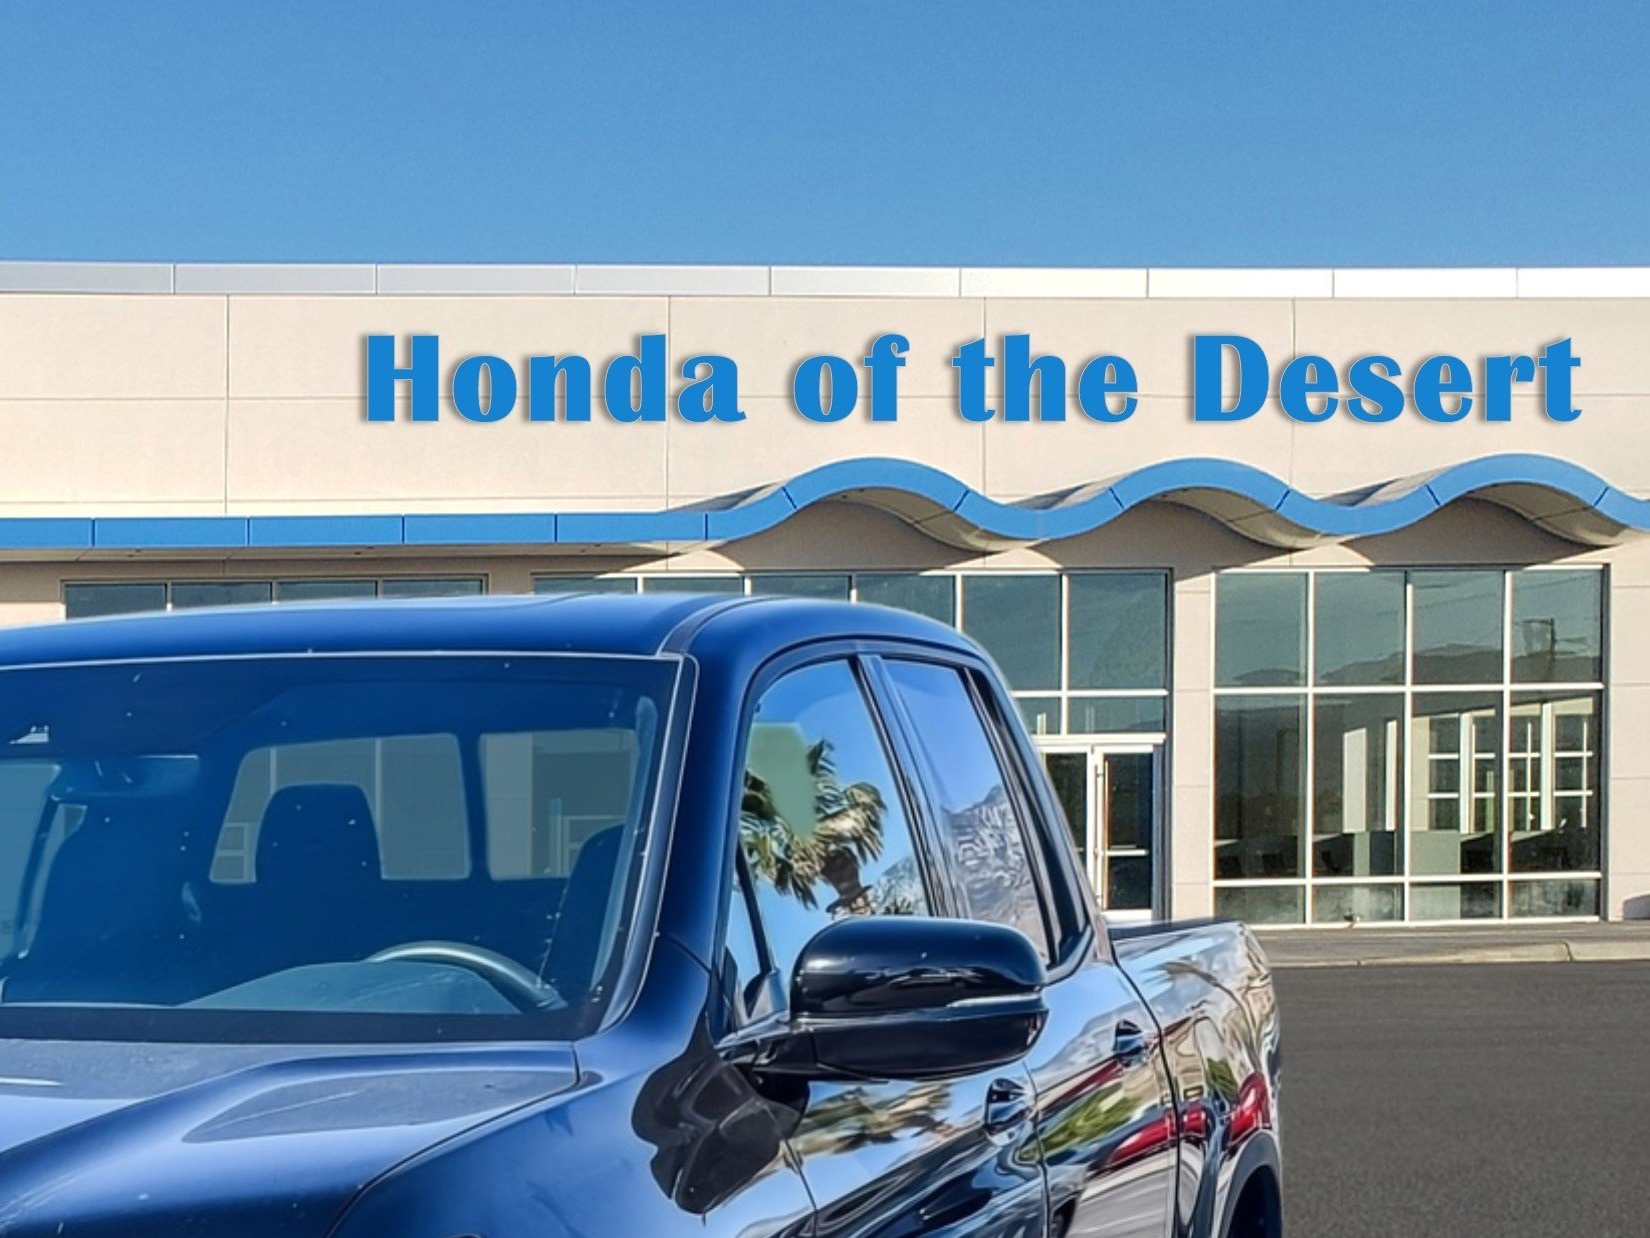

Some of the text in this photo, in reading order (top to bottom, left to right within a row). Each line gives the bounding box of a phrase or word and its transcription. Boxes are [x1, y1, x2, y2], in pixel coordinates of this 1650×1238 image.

[366, 334, 1583, 423] Honda of the Desert
